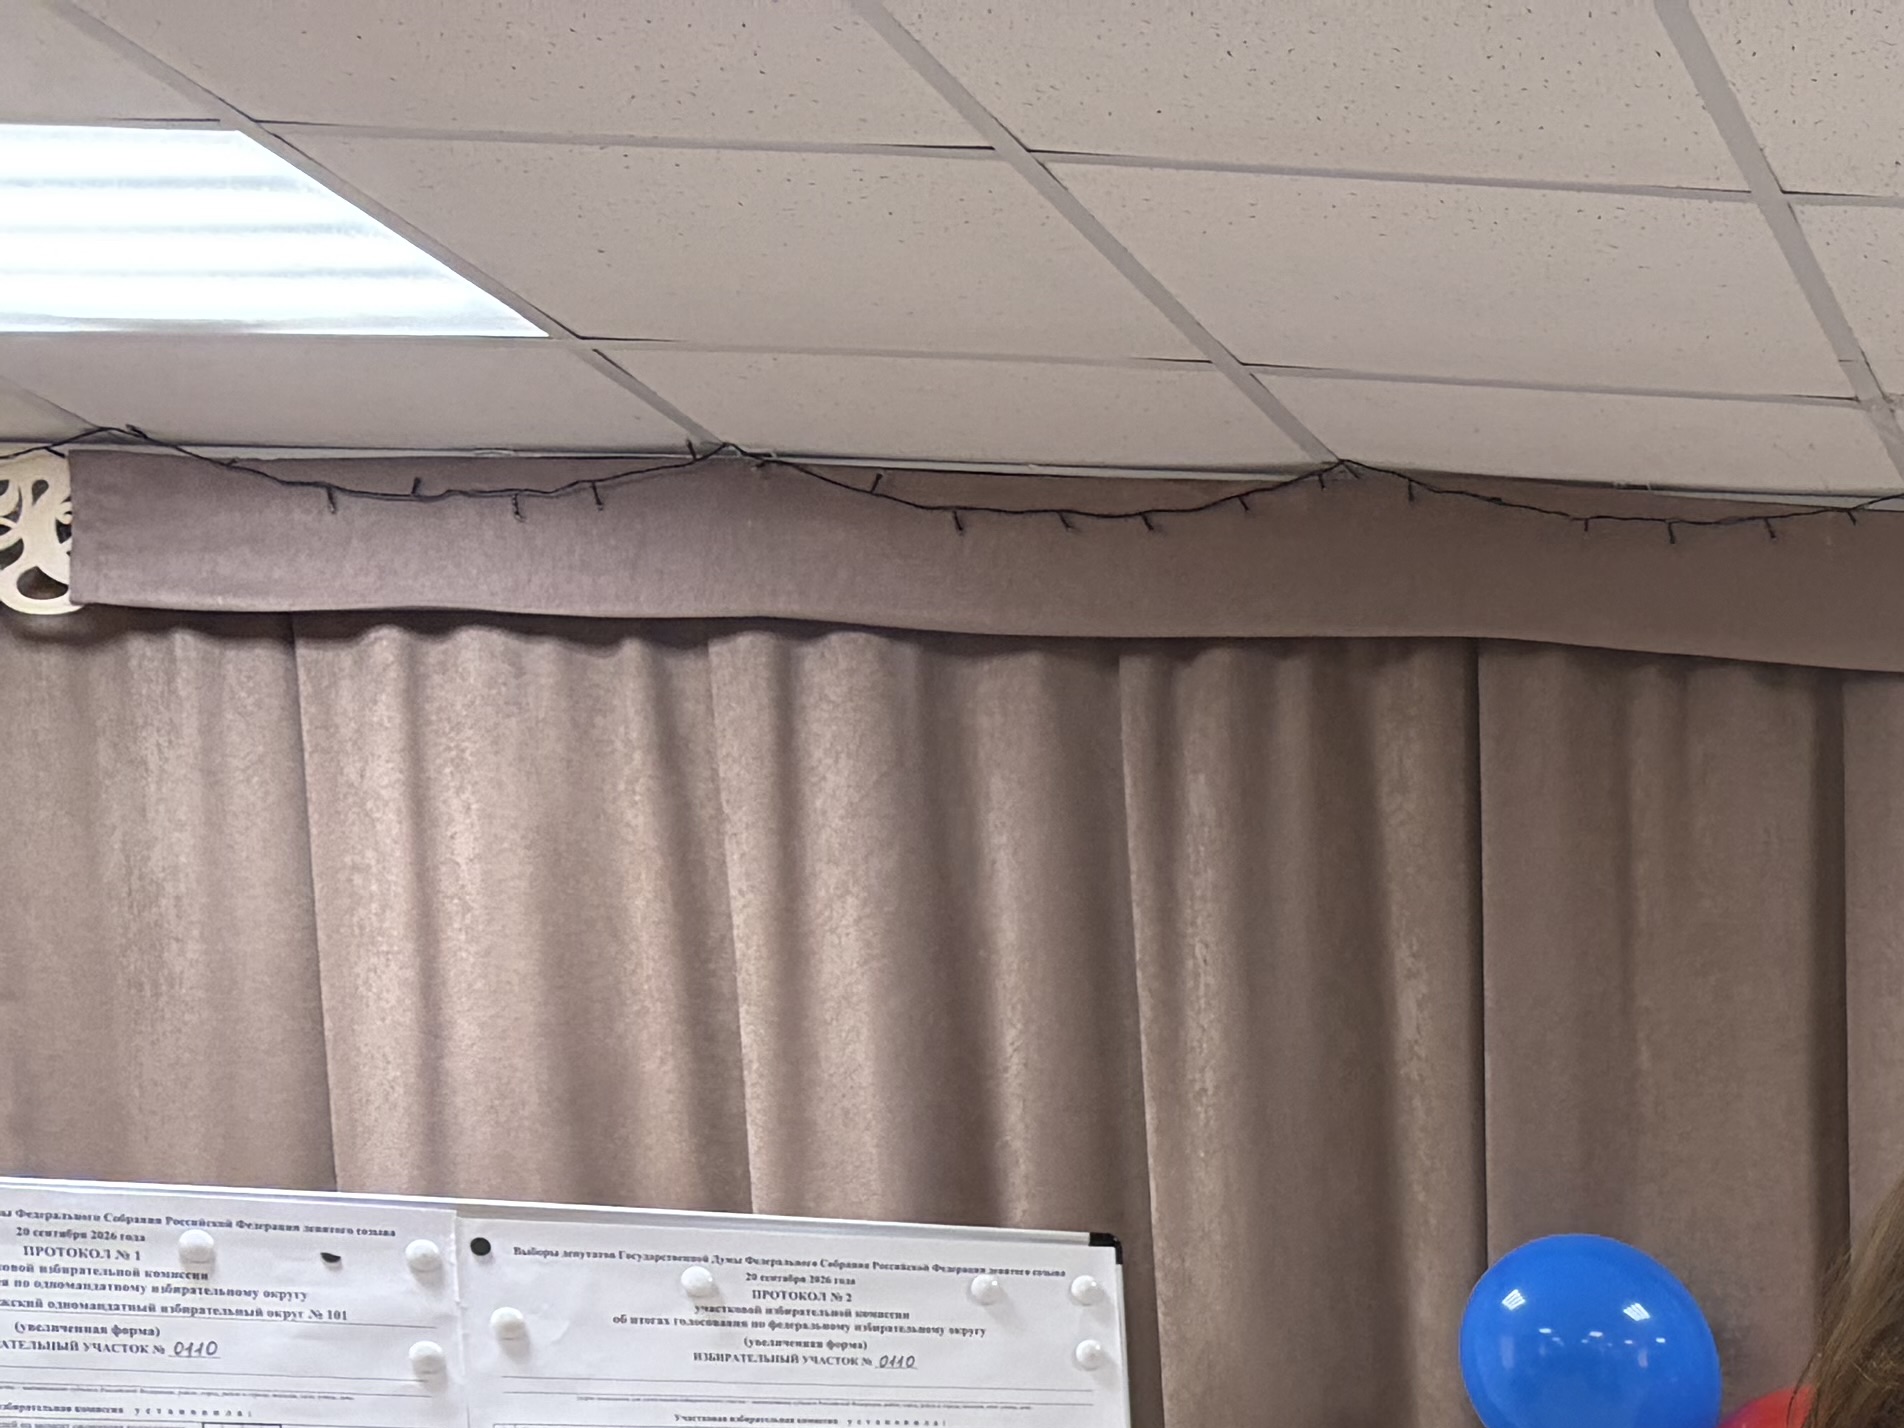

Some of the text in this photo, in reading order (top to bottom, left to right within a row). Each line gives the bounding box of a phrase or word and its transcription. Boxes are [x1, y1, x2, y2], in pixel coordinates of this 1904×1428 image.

[16, 1226, 30, 1237] 20
[33, 1229, 87, 1241] сентября
[90, 1230, 117, 1241] 2026
[23, 1245, 111, 1260] ПРОТОКОЛ
[134, 1251, 141, 1261] 1
[752, 1289, 827, 1303] ПРОТОКОЛ
[846, 1292, 852, 1302] 2
[327, 1310, 347, 1321] 101
[83, 1343, 149, 1355] УЧАСТОК
[173, 1340, 218, 1357] 0110
[693, 1352, 799, 1365] ИЗБИРАТЕЛЬНЫЙ
[802, 1355, 858, 1367] УЧАСТОК
